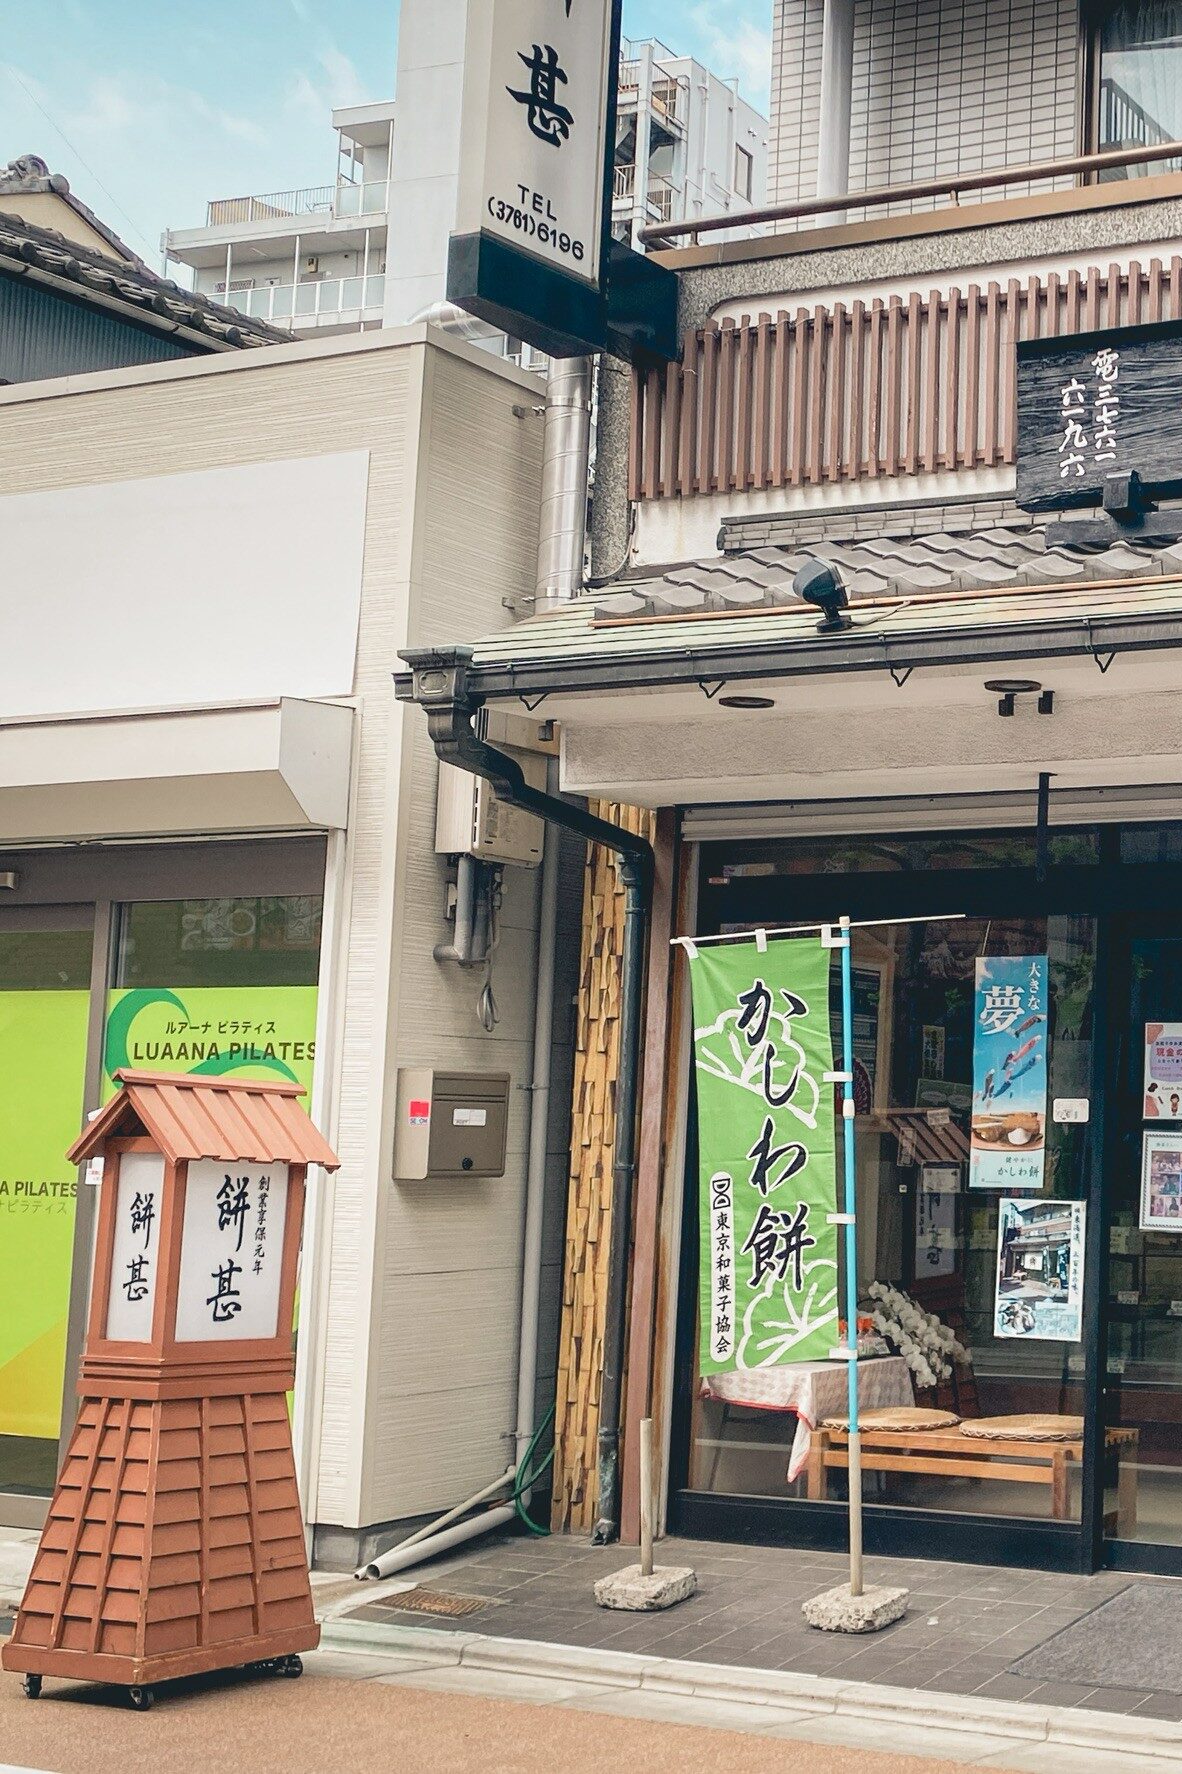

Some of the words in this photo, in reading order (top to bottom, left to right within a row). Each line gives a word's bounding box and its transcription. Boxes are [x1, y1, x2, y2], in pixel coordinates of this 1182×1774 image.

[505, 0, 574, 148] 甚
[488, 196, 584, 261] (3761)6196
[517, 184, 557, 221] TEL
[1059, 378, 1087, 479] 六一九六
[979, 985, 1025, 1035] 夢
[1028, 962, 1041, 1010] 大きな
[133, 1042, 220, 1061] LUAANA
[229, 1042, 315, 1061] PILATES
[165, 1021, 212, 1035] ルアーナ
[218, 1020, 276, 1034] ピラティス
[737, 980, 815, 1290] かしわ餅
[14, 1181, 78, 1198] PILATES
[997, 1166, 1040, 1178] かしわ餅
[122, 1191, 156, 1302] 餅甚
[205, 1174, 251, 1322] 餅甚
[252, 1175, 270, 1276] 創業享保元年
[715, 1211, 732, 1353] 東京和菓子協会
